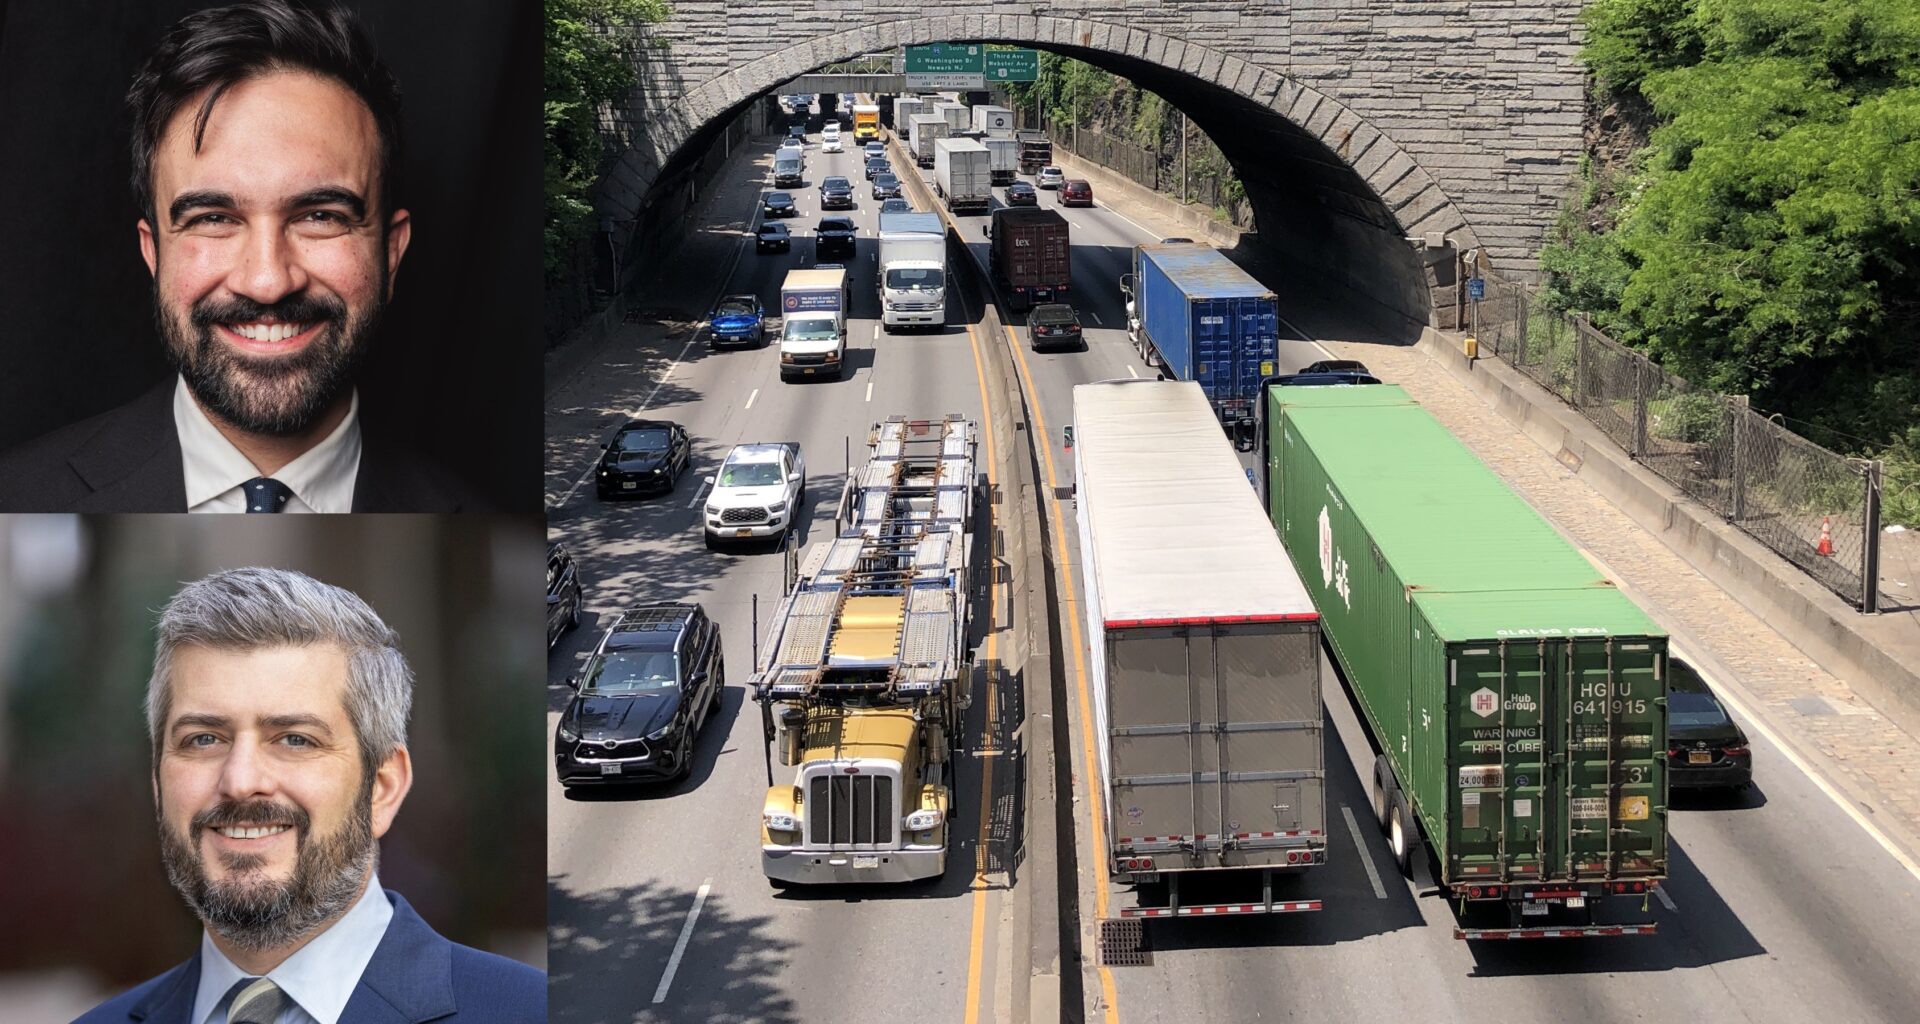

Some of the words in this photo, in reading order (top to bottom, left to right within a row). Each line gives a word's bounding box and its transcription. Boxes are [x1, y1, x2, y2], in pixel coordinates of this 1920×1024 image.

[1015, 238, 1030, 247] tex
[1581, 682, 1631, 698] HGIU
[1511, 693, 1531, 702] Hub
[1504, 700, 1537, 712] Group
[1573, 700, 1646, 715] 641915
[1473, 728, 1536, 739] WARNING
[1472, 743, 1502, 754] HIGH
[1507, 743, 1541, 753] CUBE
